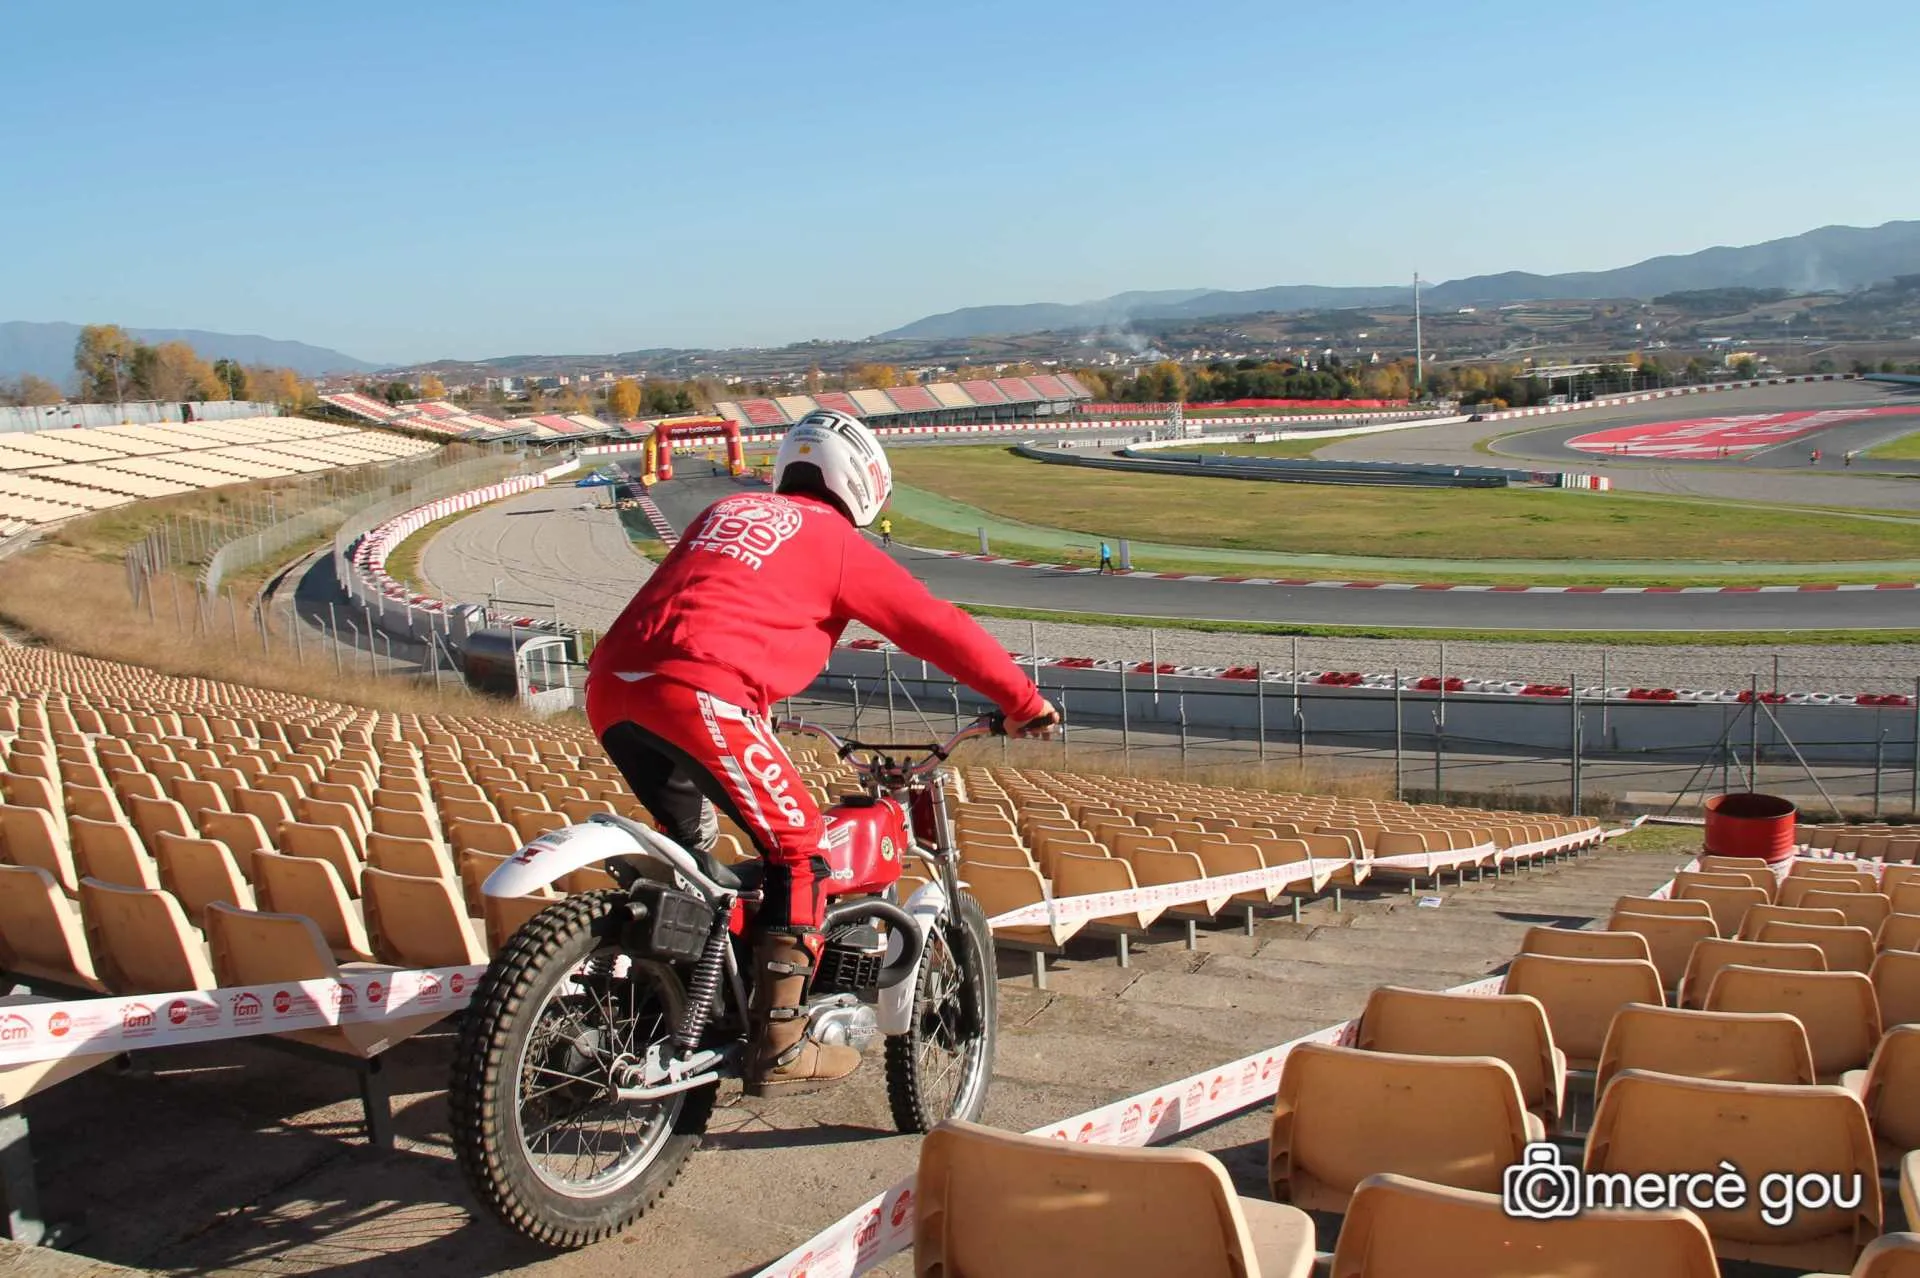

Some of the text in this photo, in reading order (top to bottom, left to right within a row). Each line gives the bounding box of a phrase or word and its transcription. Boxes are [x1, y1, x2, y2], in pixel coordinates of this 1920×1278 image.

[697, 514, 781, 556] 199
[688, 540, 763, 571] TEAM
[0, 1026, 28, 1040] cm
